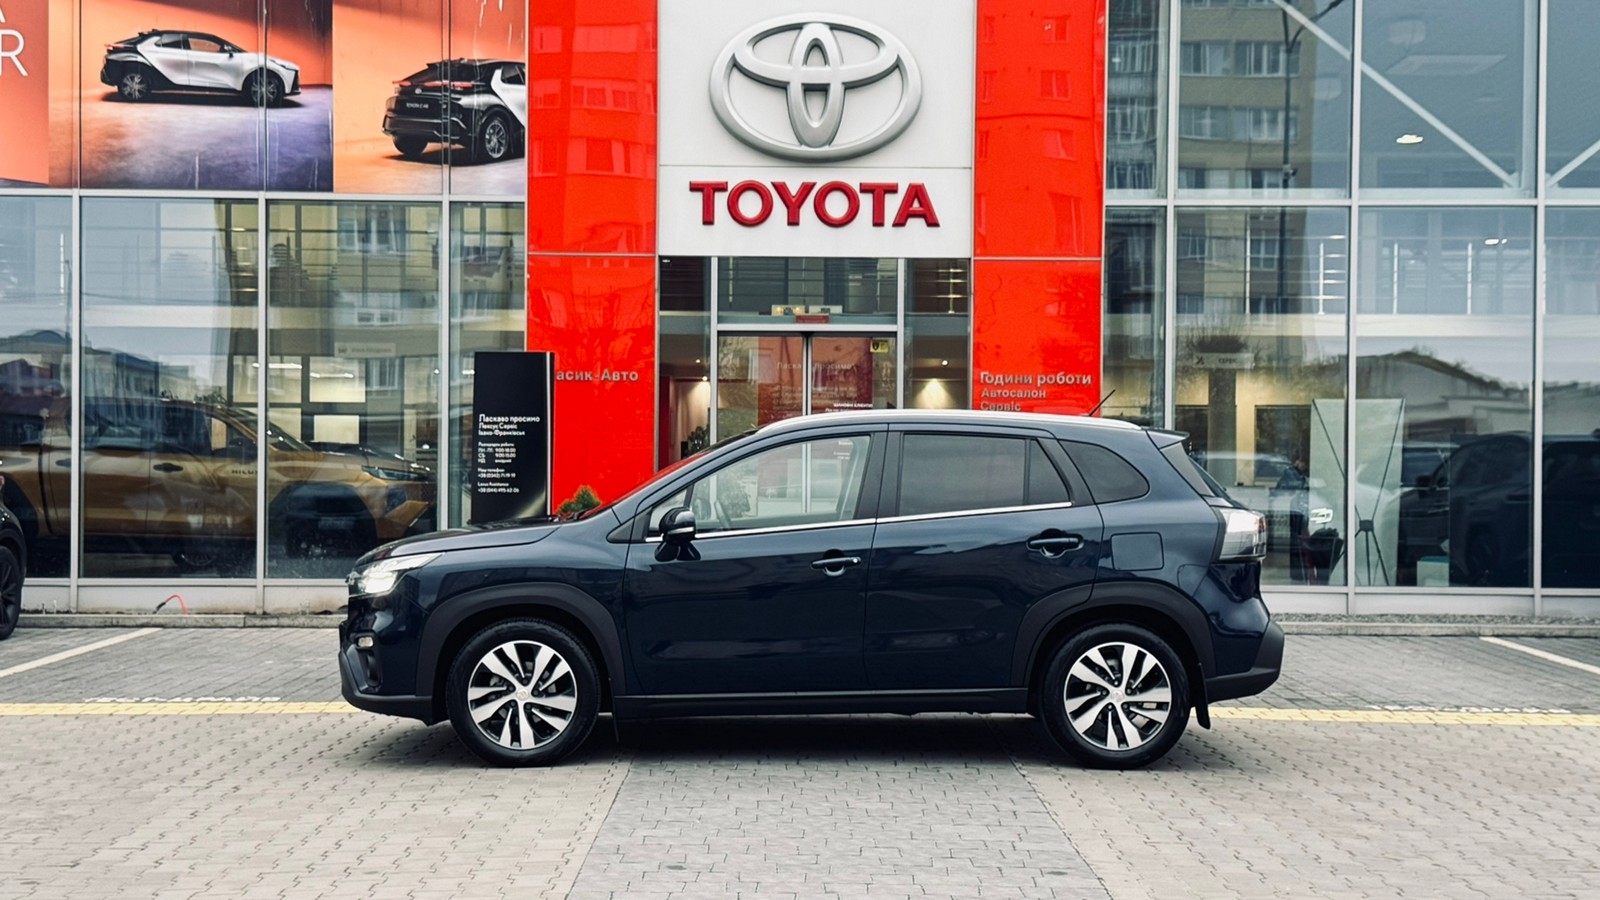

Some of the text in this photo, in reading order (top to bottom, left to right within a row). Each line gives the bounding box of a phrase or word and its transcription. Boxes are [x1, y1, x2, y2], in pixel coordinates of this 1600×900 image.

[689, 180, 940, 228] TOYOTA
[980, 371, 1092, 388] Години роботи
[981, 388, 1047, 399] Автосалон
[479, 414, 509, 422] Ласкаво
